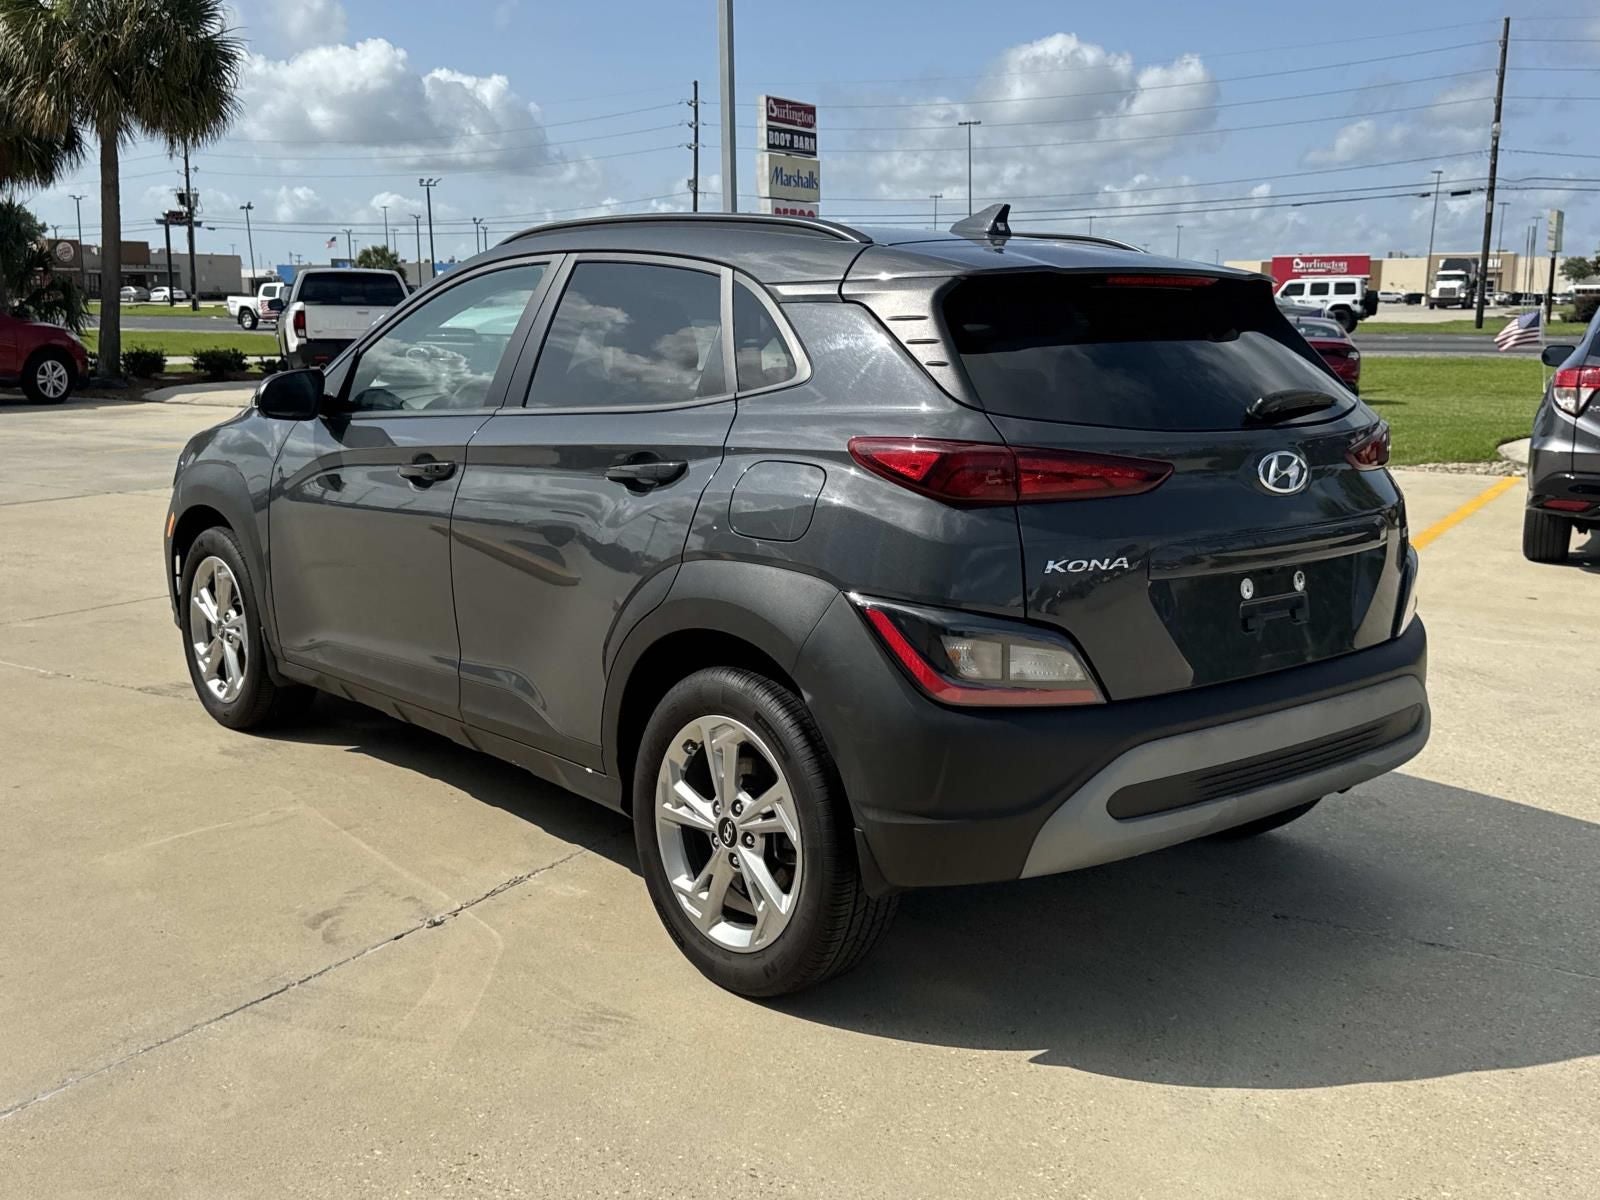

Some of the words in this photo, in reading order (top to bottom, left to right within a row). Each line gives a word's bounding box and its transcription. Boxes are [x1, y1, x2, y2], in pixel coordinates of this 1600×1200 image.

[768, 98, 814, 125] Burlington
[768, 131, 792, 147] BOOT
[794, 135, 815, 152] BARN
[770, 166, 818, 190] Marshalls
[1293, 258, 1347, 273] Burlington
[1044, 557, 1129, 574] KONA
